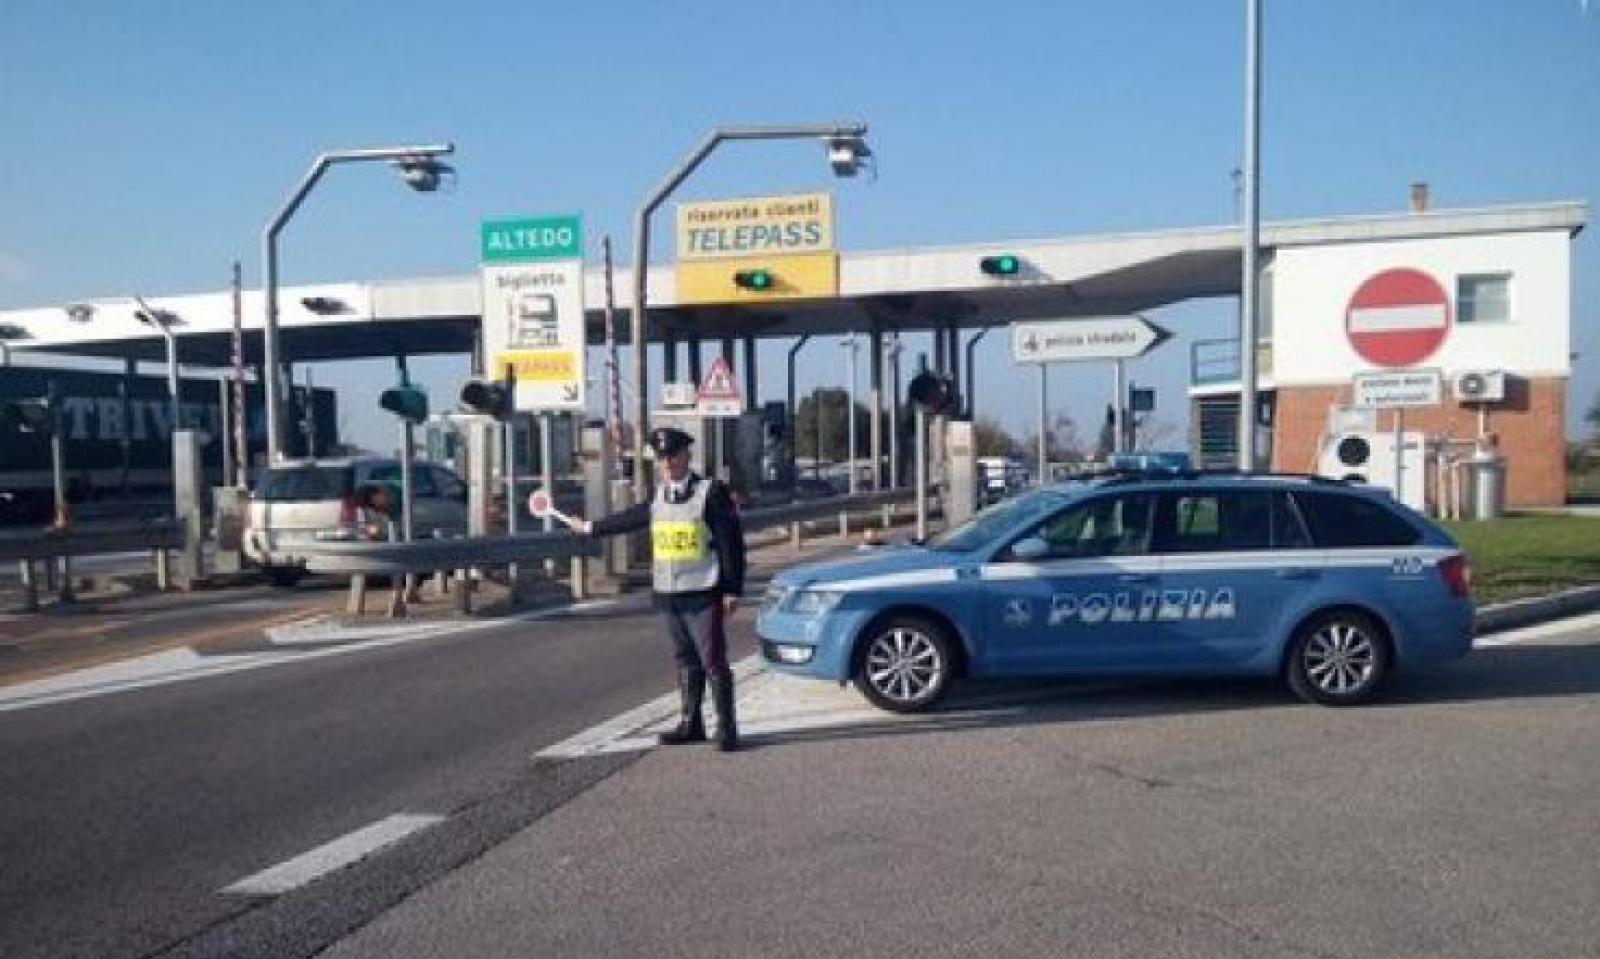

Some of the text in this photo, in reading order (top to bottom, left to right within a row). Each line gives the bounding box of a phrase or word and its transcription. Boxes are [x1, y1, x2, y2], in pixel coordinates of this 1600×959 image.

[487, 227, 572, 251] ALTEDO
[687, 221, 821, 251] TELEPASS
[1049, 588, 1236, 625] POLIZIA
